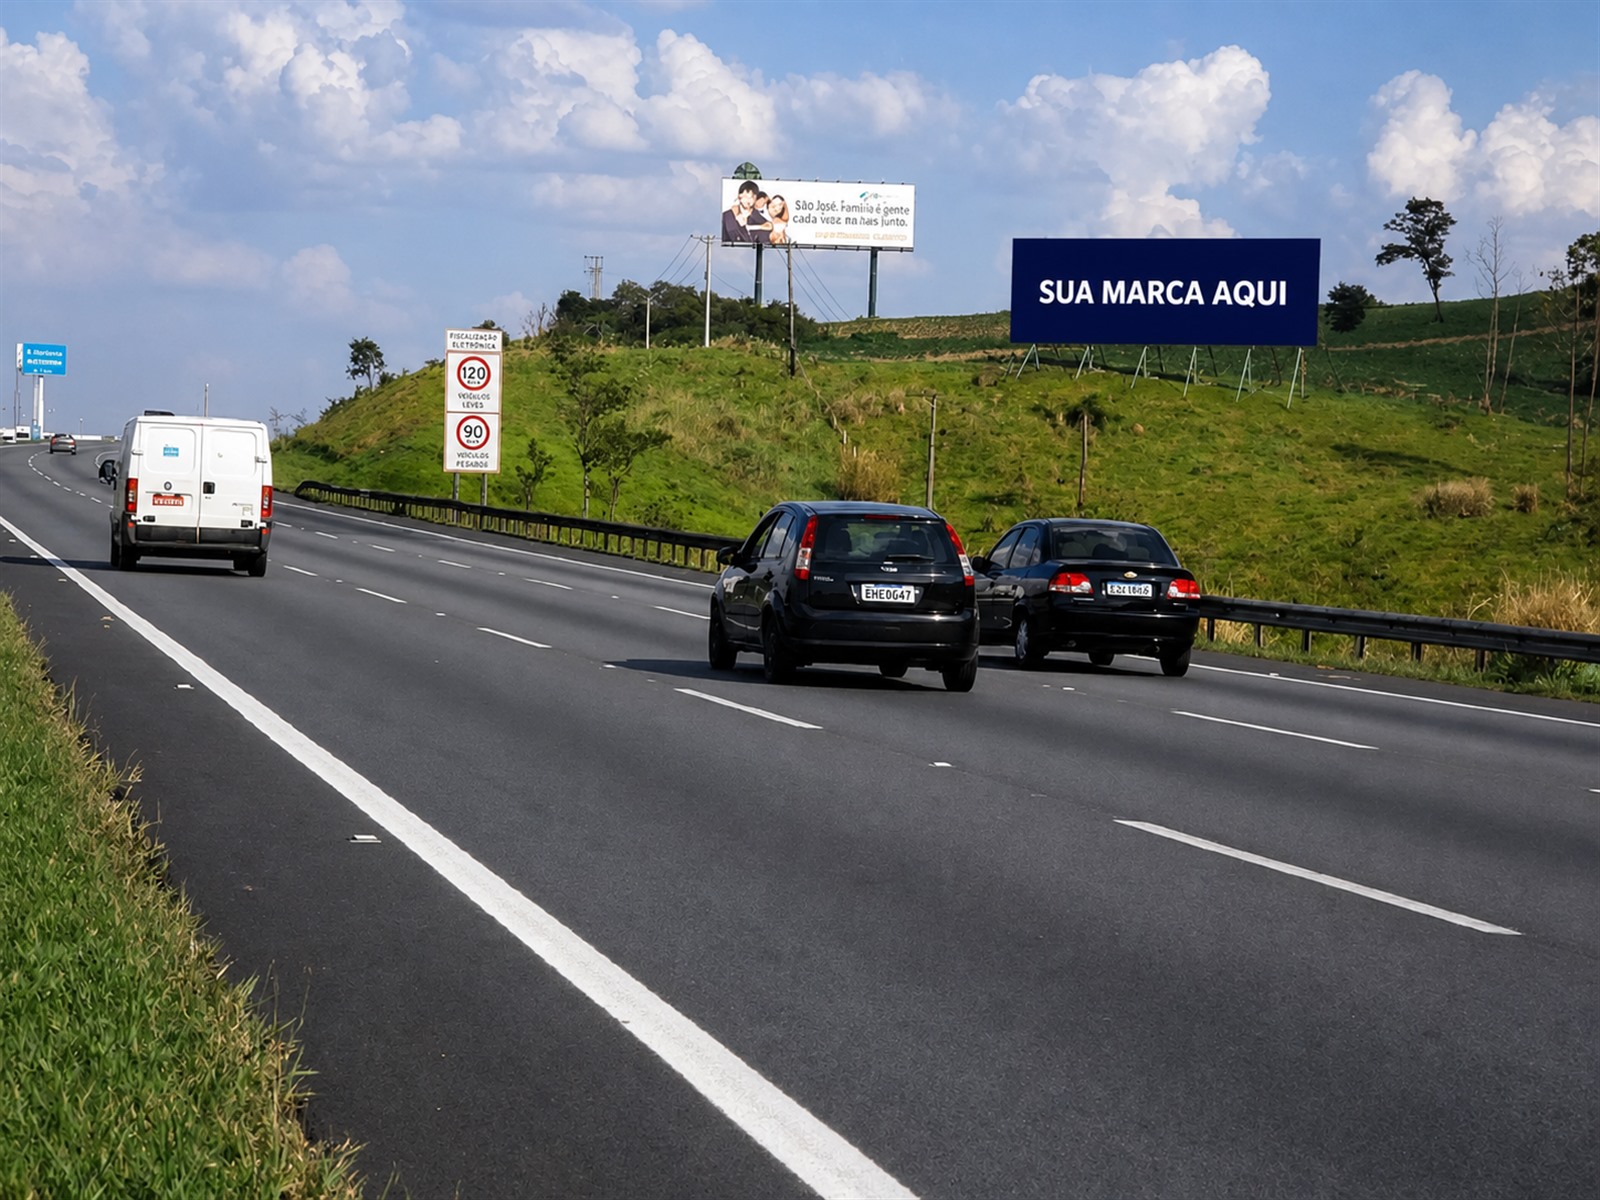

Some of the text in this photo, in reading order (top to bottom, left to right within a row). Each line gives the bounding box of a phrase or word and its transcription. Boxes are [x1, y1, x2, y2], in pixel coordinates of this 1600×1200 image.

[795, 199, 814, 211] São
[816, 200, 839, 212] José.
[883, 206, 910, 217] gente
[792, 213, 817, 224] cada
[1039, 279, 1287, 308] SUA MARCA AQUI
[462, 366, 486, 380] 120
[462, 401, 484, 409] LEVES
[463, 424, 483, 439] 90
[455, 460, 488, 468] PESADOS
